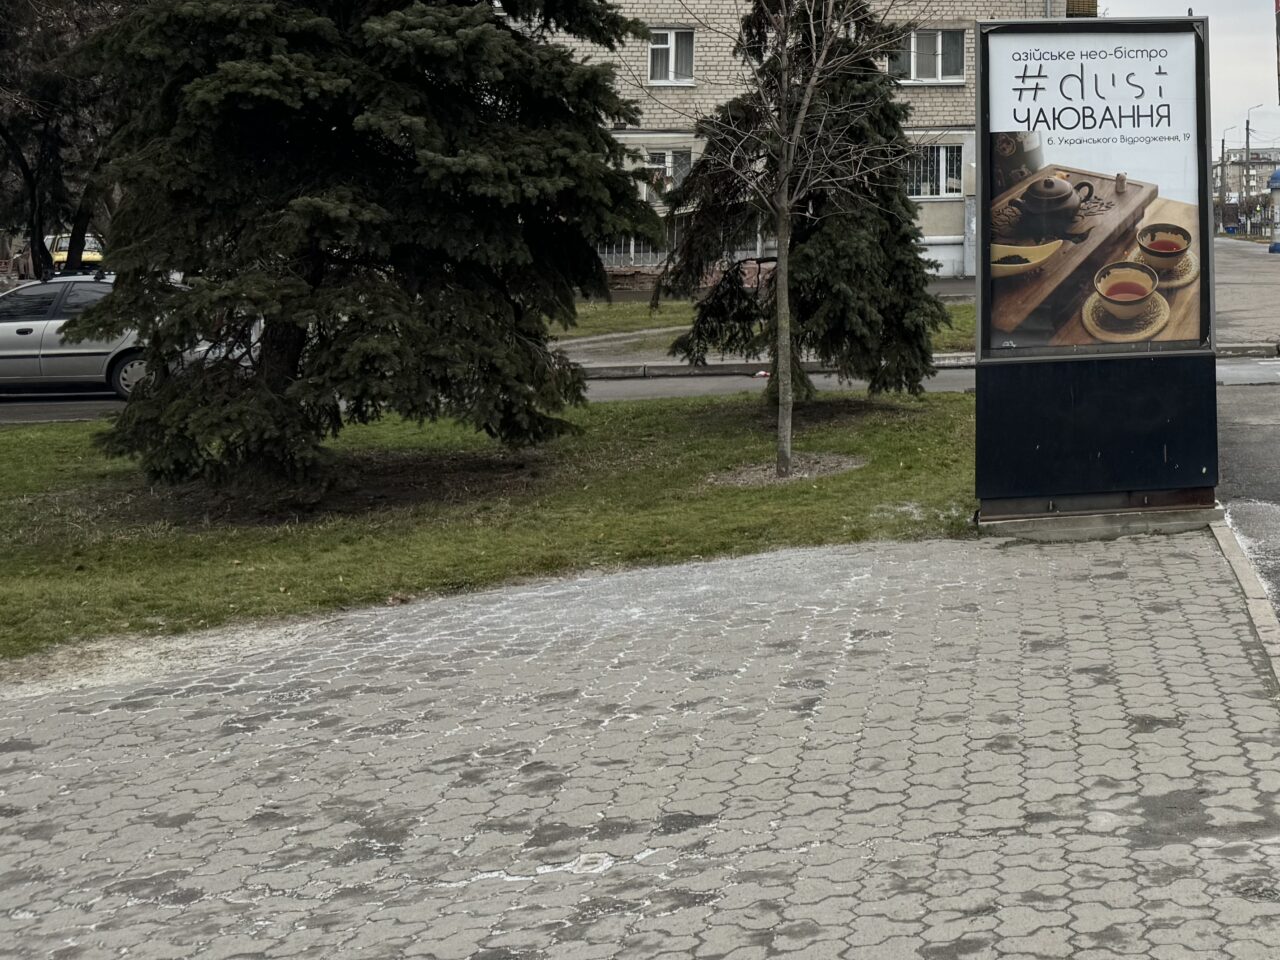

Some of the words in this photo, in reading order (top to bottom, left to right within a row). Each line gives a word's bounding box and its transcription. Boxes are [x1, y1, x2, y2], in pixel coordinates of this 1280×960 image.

[1012, 48, 1076, 62] азійське
[1080, 46, 1168, 61] нео-бістро
[1013, 103, 1171, 132] ЧАЮВАННЯ
[1047, 136, 1056, 146] б.
[1057, 136, 1117, 146] Українського
[1119, 133, 1181, 145] Відродження,
[1183, 132, 1191, 141] 19
